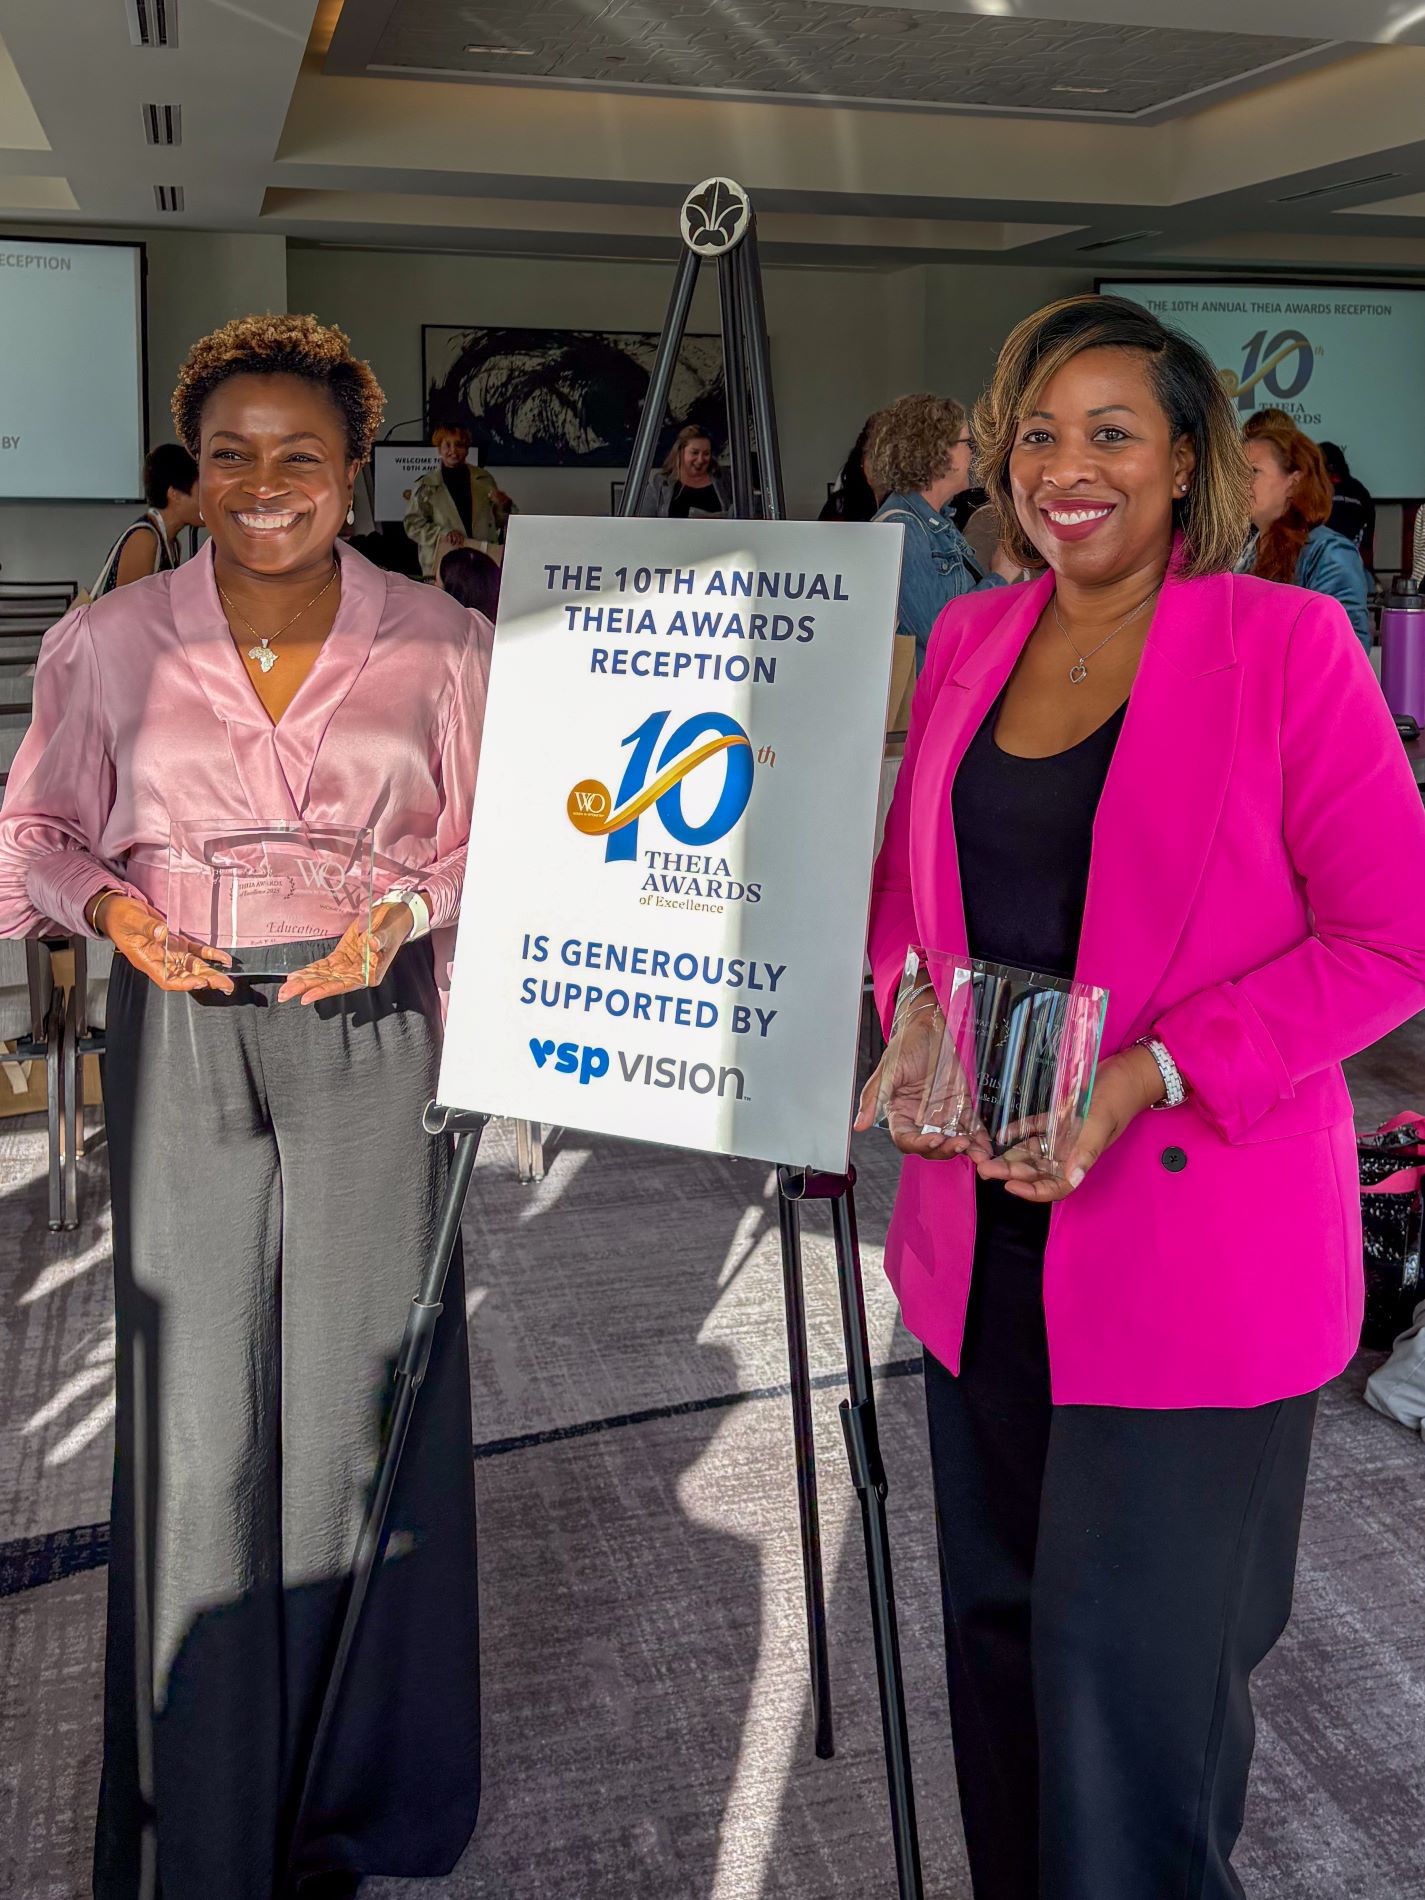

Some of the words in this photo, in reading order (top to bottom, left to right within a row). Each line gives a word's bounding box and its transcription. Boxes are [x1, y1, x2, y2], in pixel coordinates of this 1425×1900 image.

[1147, 300, 1168, 311] THE
[1171, 301, 1199, 312] 10TH
[1201, 301, 1247, 313] ANNUAL
[1251, 302, 1282, 314] THEIA
[1284, 303, 1332, 315] AWARDS
[1334, 304, 1392, 316] RECEPTION
[1238, 329, 1314, 411] 10
[2, 435, 21, 450] BY
[544, 564, 603, 592] THE
[615, 567, 696, 595] 10TH
[705, 570, 849, 601] ANNUAL
[565, 606, 657, 635] THEIA
[666, 610, 815, 643] AWARDS
[590, 648, 777, 684] RECEPTION
[605, 710, 755, 864] 10
[756, 744, 776, 769] th
[644, 850, 732, 878] THEIA
[639, 895, 654, 906] of
[655, 896, 724, 914] Excellence
[641, 873, 762, 904] AWARDS
[266, 921, 329, 936] Education
[522, 934, 550, 963] IS
[560, 939, 787, 992] GENEROUSLY
[520, 977, 719, 1029] SUPPORTED
[731, 1005, 778, 1038] BY
